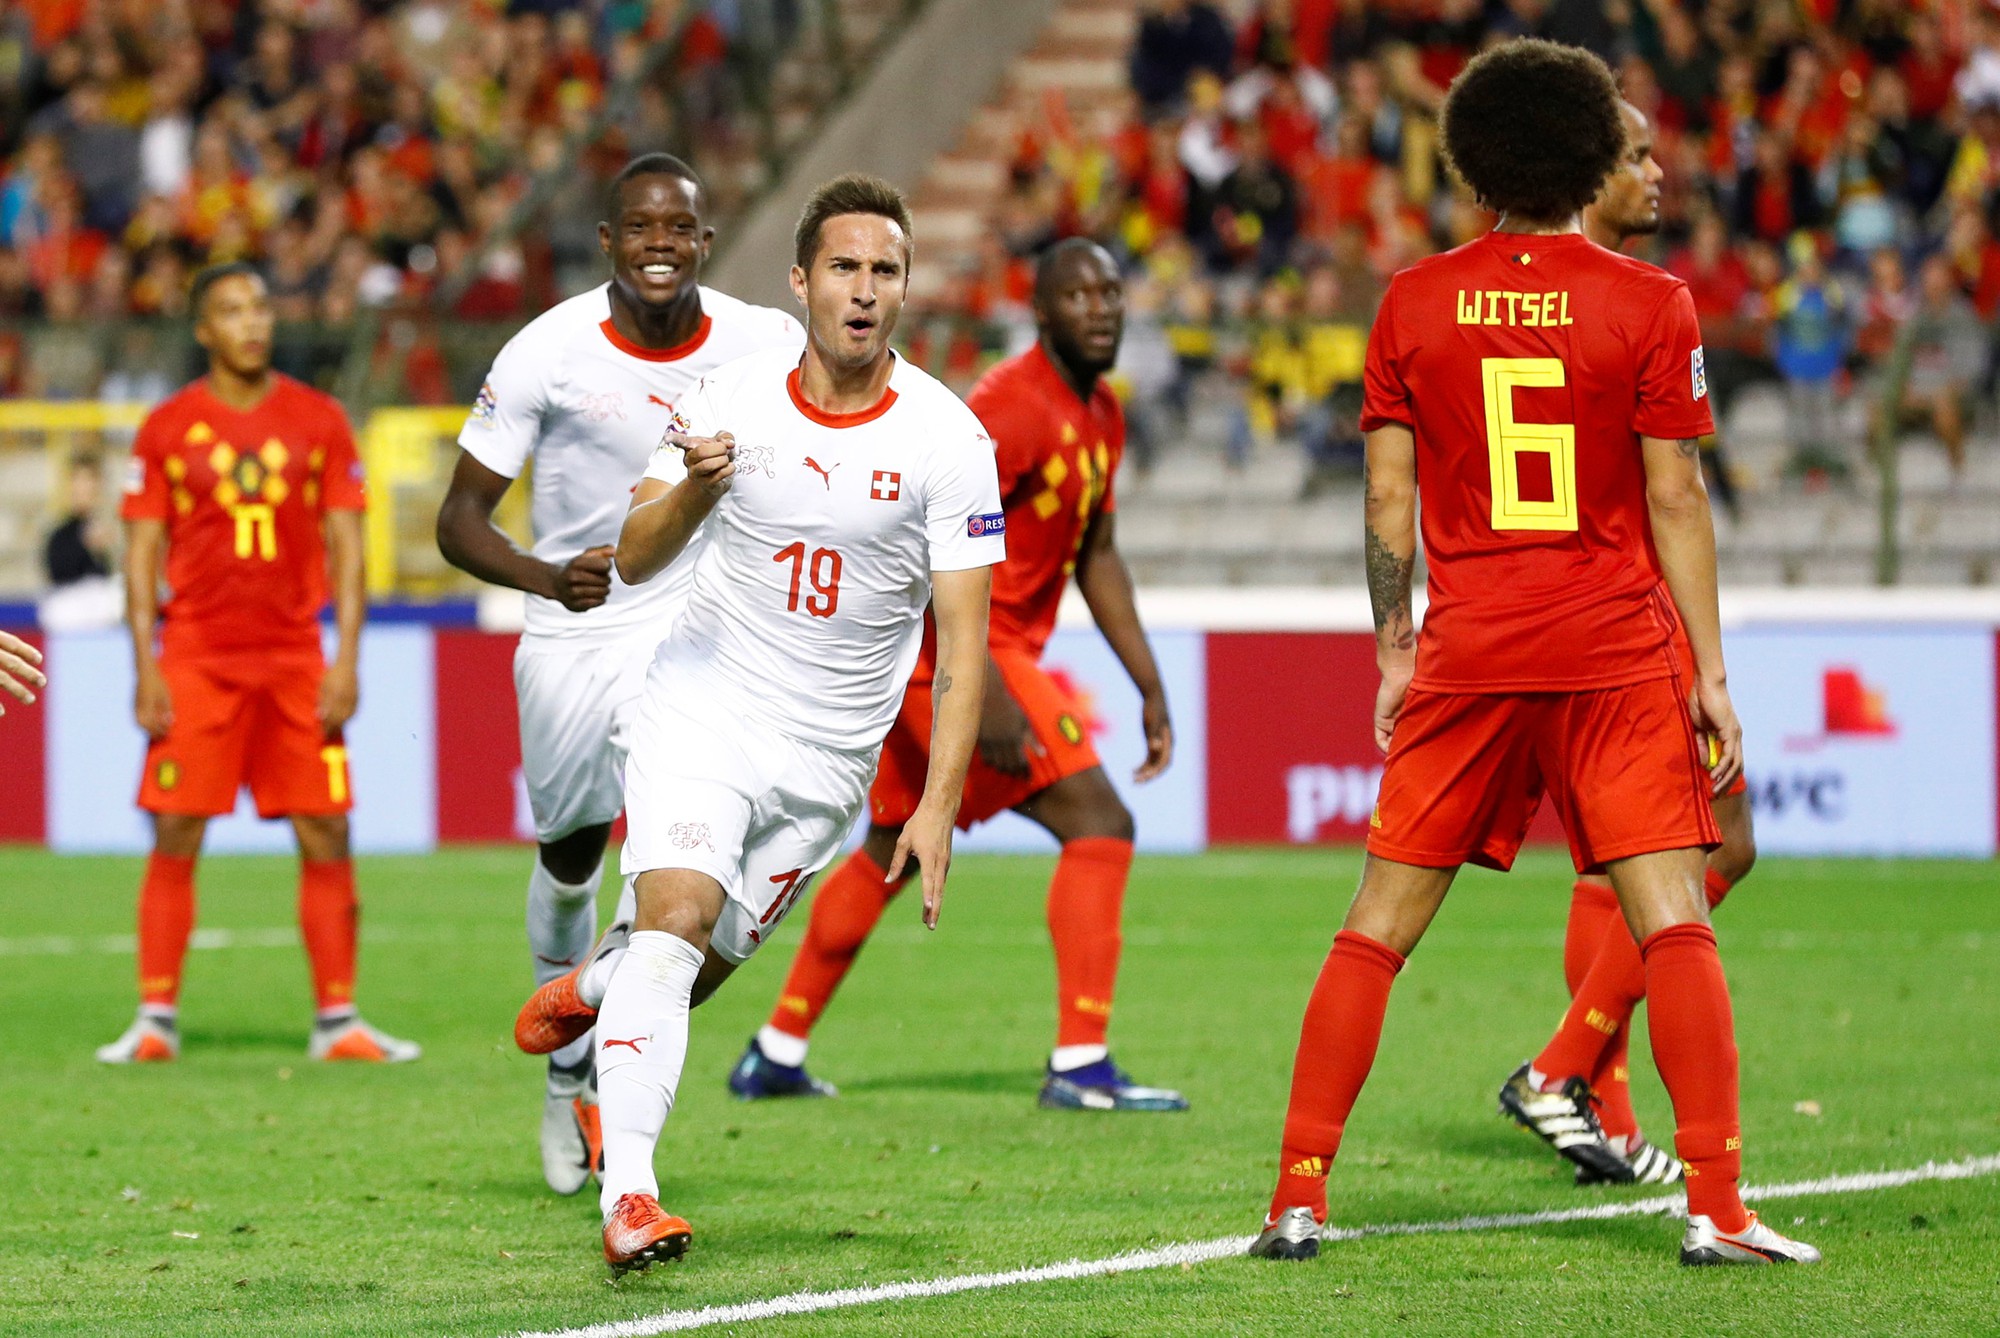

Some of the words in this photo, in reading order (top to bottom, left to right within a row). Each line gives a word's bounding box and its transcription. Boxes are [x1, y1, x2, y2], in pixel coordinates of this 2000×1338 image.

[1457, 290, 1573, 327] WITSEL
[1481, 358, 1579, 531] 6
[773, 541, 842, 618] 19
